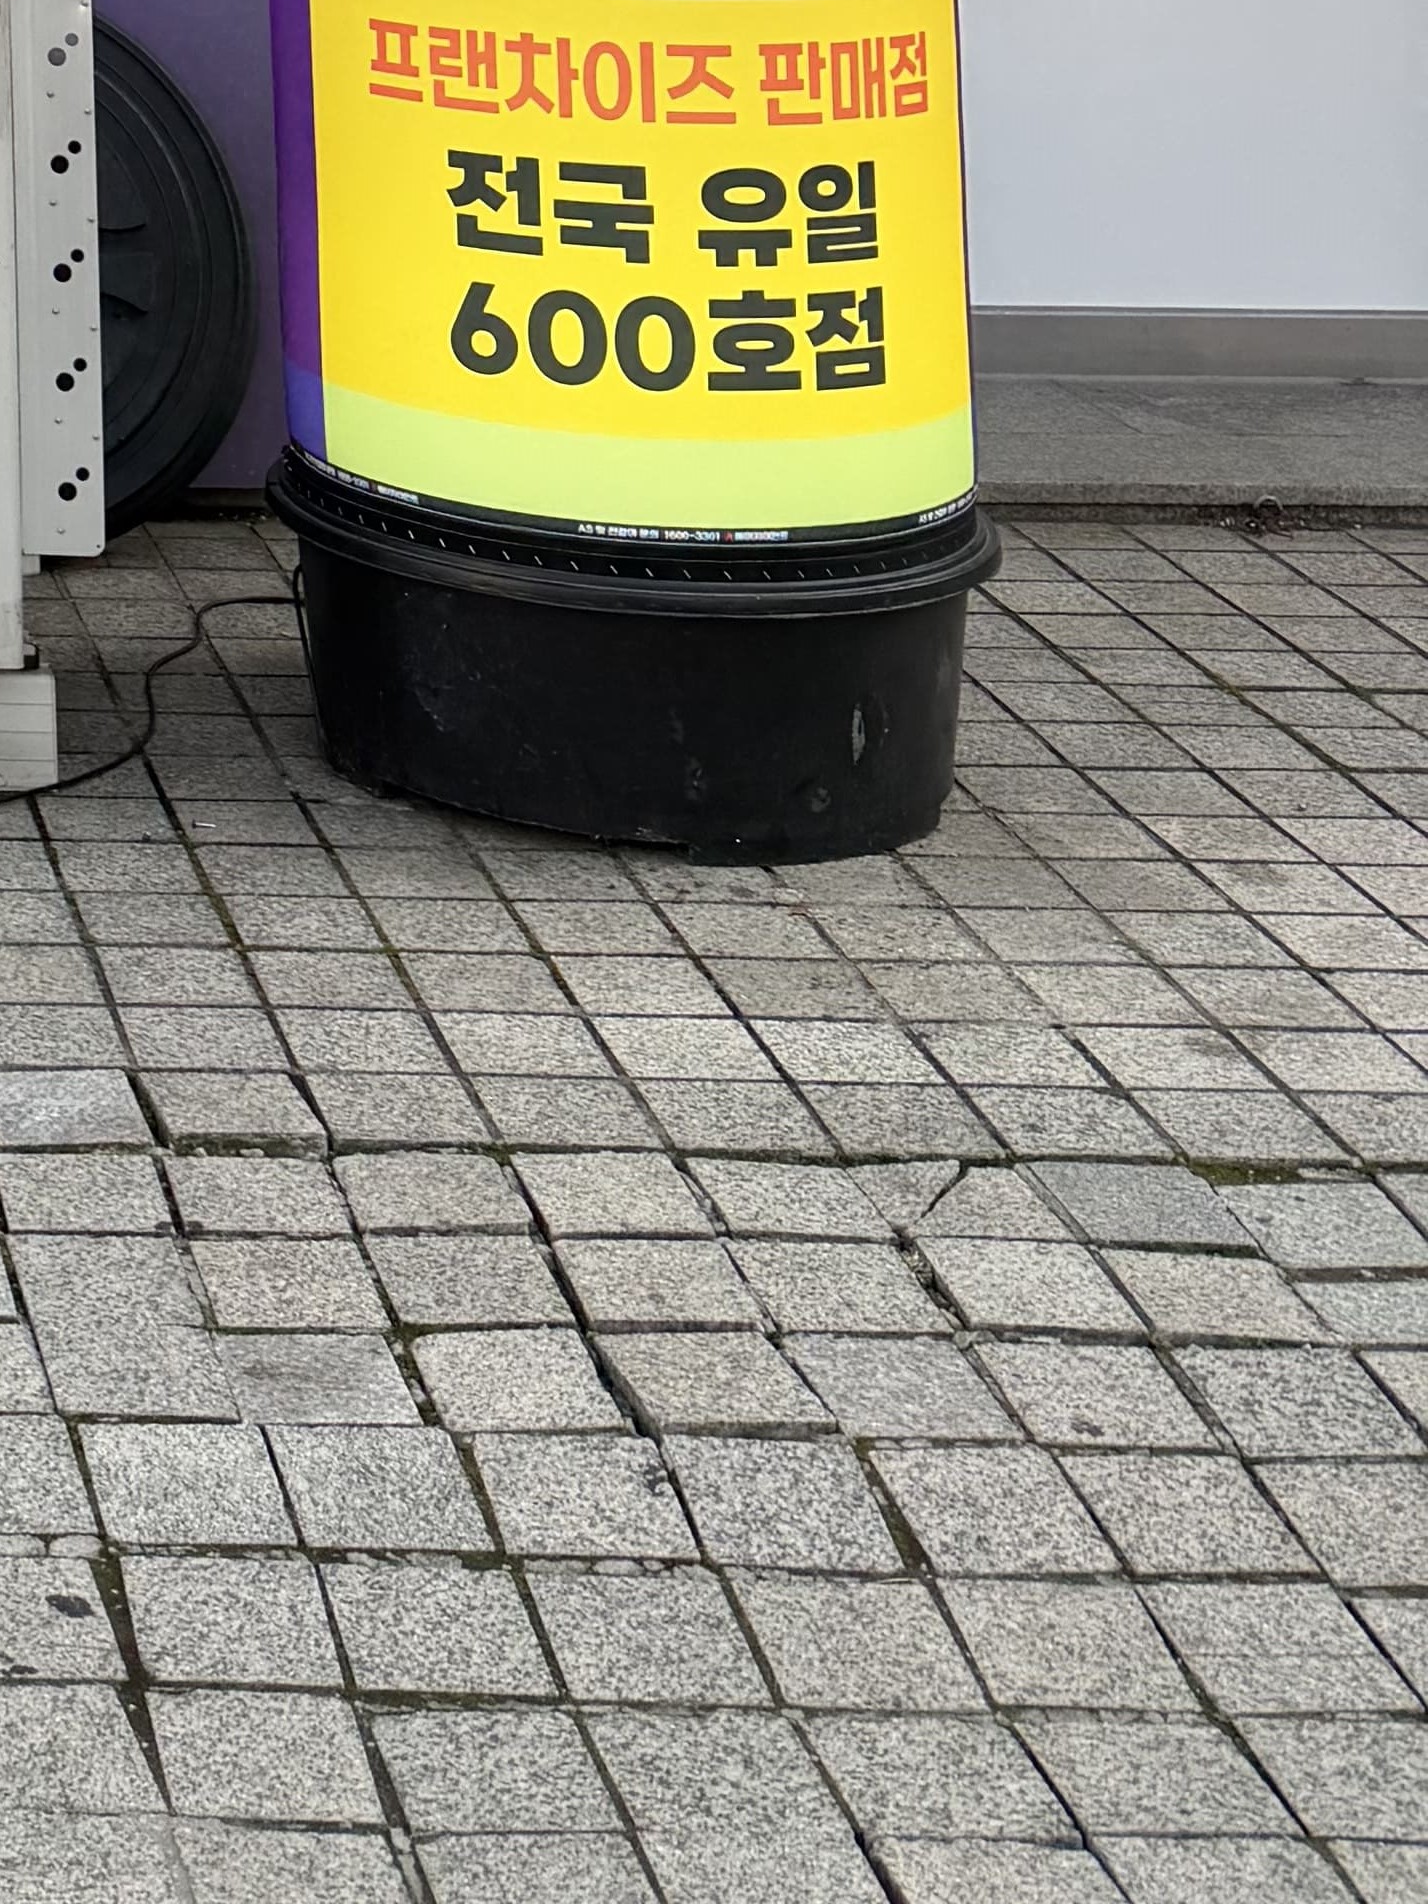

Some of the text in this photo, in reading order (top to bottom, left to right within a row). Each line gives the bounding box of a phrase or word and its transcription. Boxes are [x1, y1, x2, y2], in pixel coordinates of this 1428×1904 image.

[368, 19, 929, 128] 프랜차이즈 판매점
[447, 149, 878, 268] 전국 유일
[450, 283, 886, 392] 600호점
